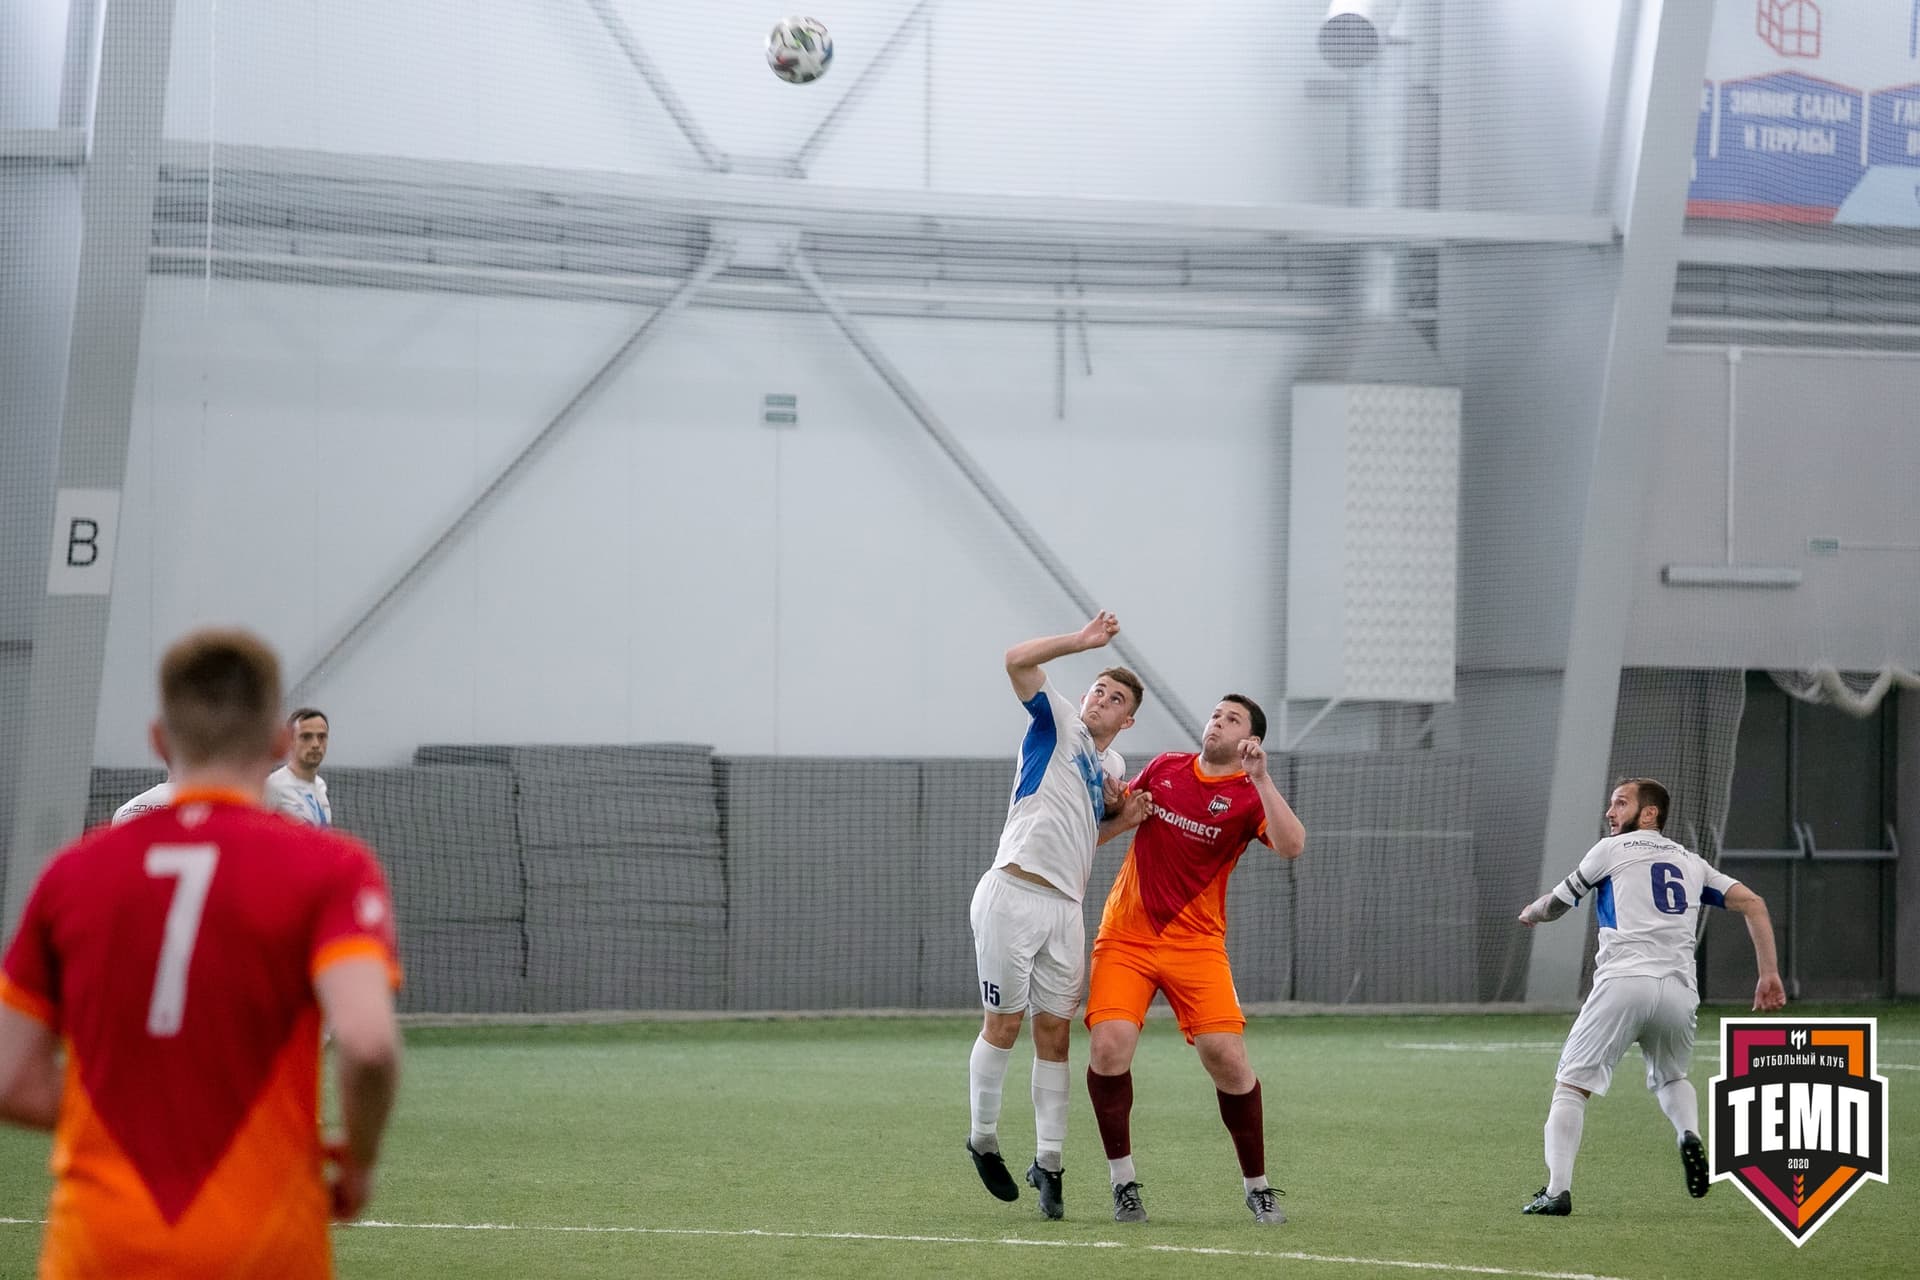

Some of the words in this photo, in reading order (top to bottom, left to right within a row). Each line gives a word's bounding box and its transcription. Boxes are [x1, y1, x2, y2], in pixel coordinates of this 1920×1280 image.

[1730, 90, 1797, 117] ЗИМНИЕ
[1801, 94, 1851, 123] САДЫ
[1744, 126, 1756, 150] И
[1761, 127, 1836, 155] ТЕРРАСЫ
[1153, 804, 1222, 839] РОДИНВЕСТ
[1650, 862, 1688, 915] 6
[146, 845, 218, 1036] 7
[983, 981, 1000, 1006] 15
